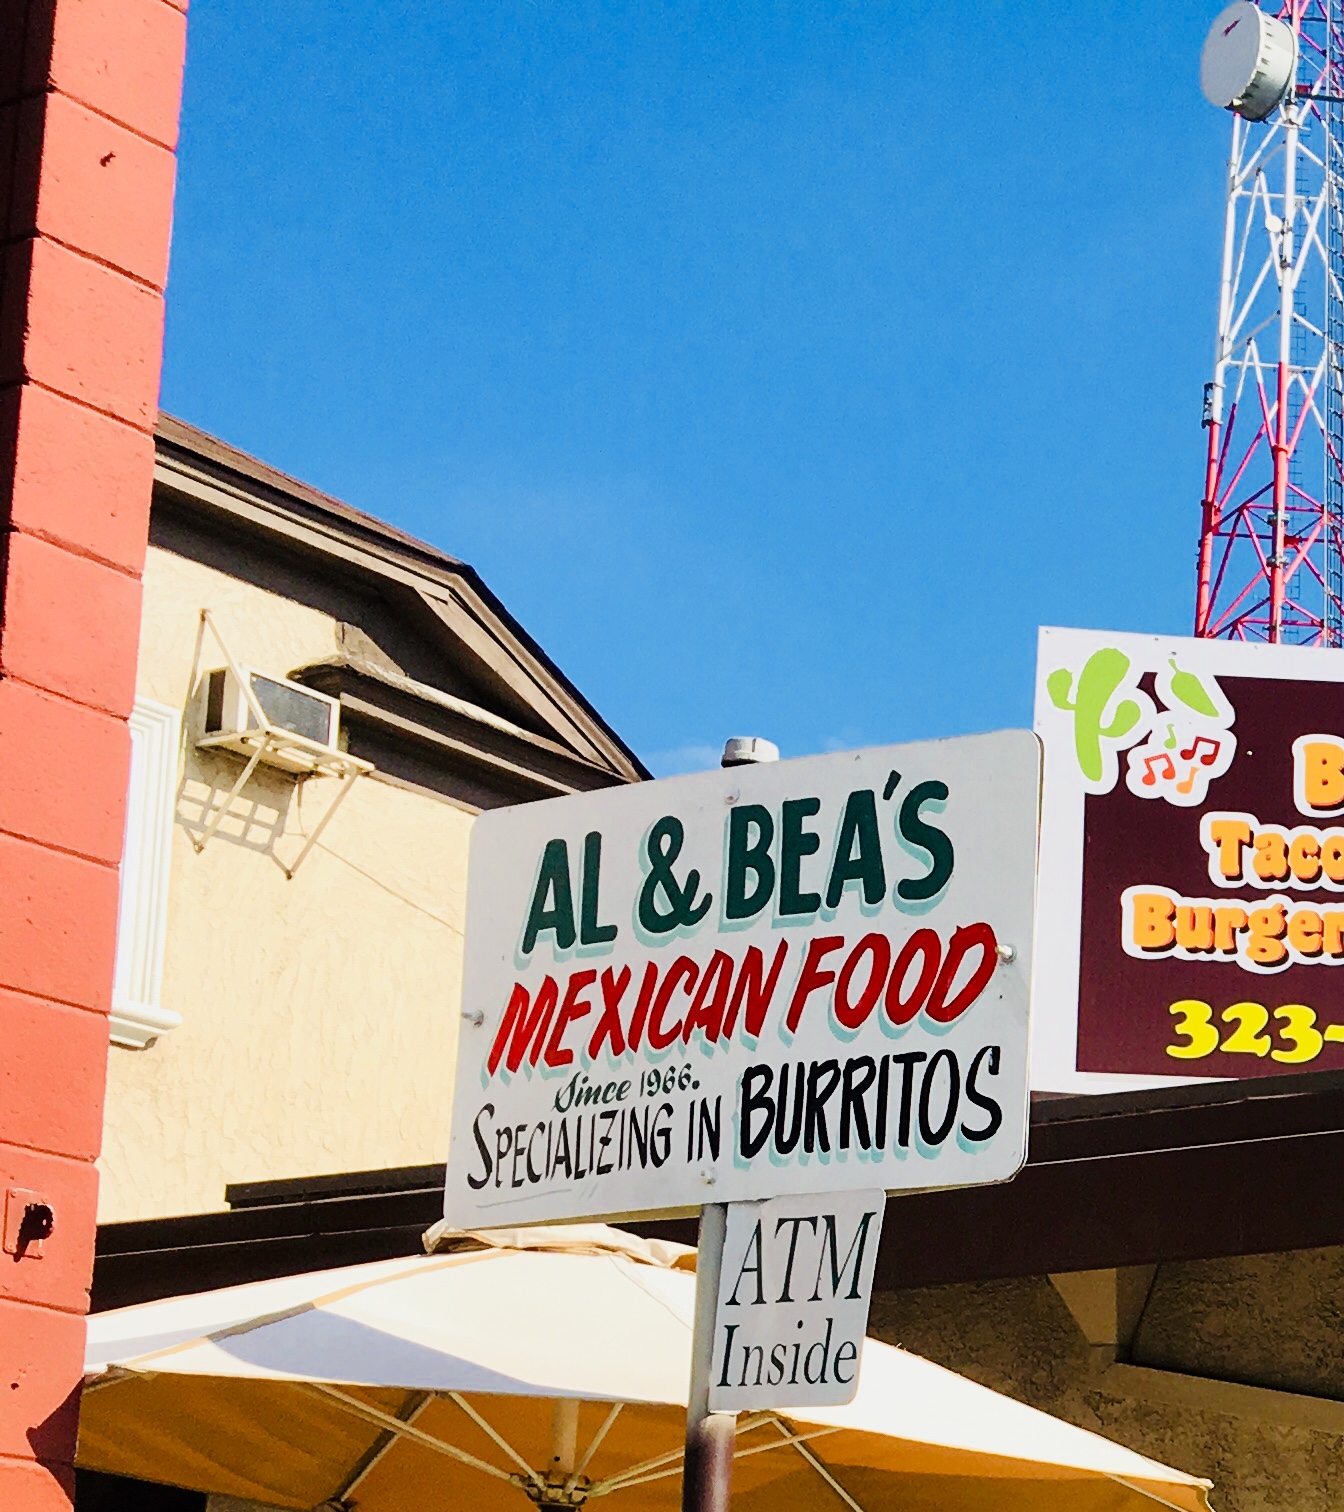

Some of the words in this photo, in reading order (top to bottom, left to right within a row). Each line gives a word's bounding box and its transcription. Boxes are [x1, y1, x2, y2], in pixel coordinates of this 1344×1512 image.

[522, 832, 618, 955] AL
[639, 815, 712, 934] &
[725, 770, 954, 920] BEA'S
[489, 938, 788, 1077] MEXICAN
[787, 921, 999, 1034] FOOD
[467, 1102, 674, 1189] SPECIALIZING
[687, 1095, 723, 1163] IN
[740, 1045, 1002, 1161] BURRITOS
[553, 1070, 632, 1113] Since
[725, 1211, 877, 1306] ATM
[716, 1317, 858, 1387] Inside
